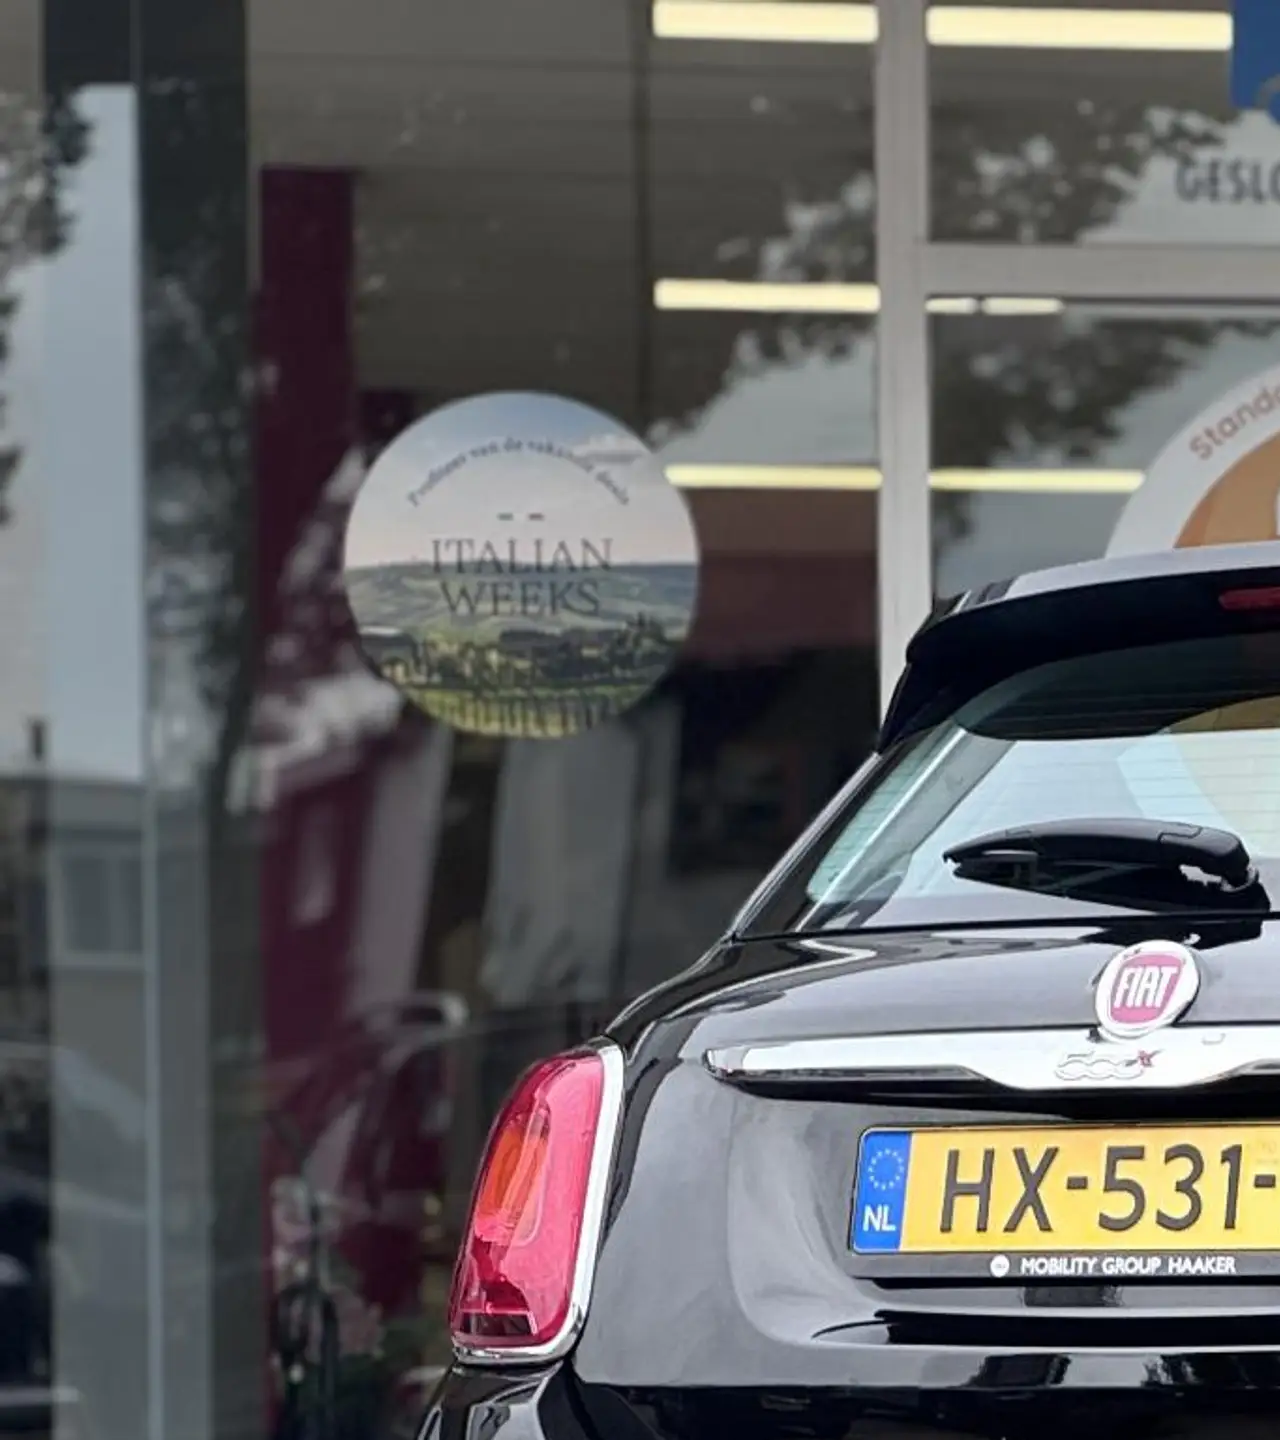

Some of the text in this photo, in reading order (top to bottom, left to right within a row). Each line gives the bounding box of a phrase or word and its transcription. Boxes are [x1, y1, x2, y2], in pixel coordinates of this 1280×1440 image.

[430, 537, 614, 575] ITALIAN
[439, 579, 600, 617] WEEKS
[1112, 962, 1183, 1010] FIAT
[862, 1204, 897, 1233] NL
[1020, 1255, 1099, 1275] MOBILITY
[1102, 1255, 1162, 1275] GROUP
[1167, 1255, 1236, 1275] HAAKER
